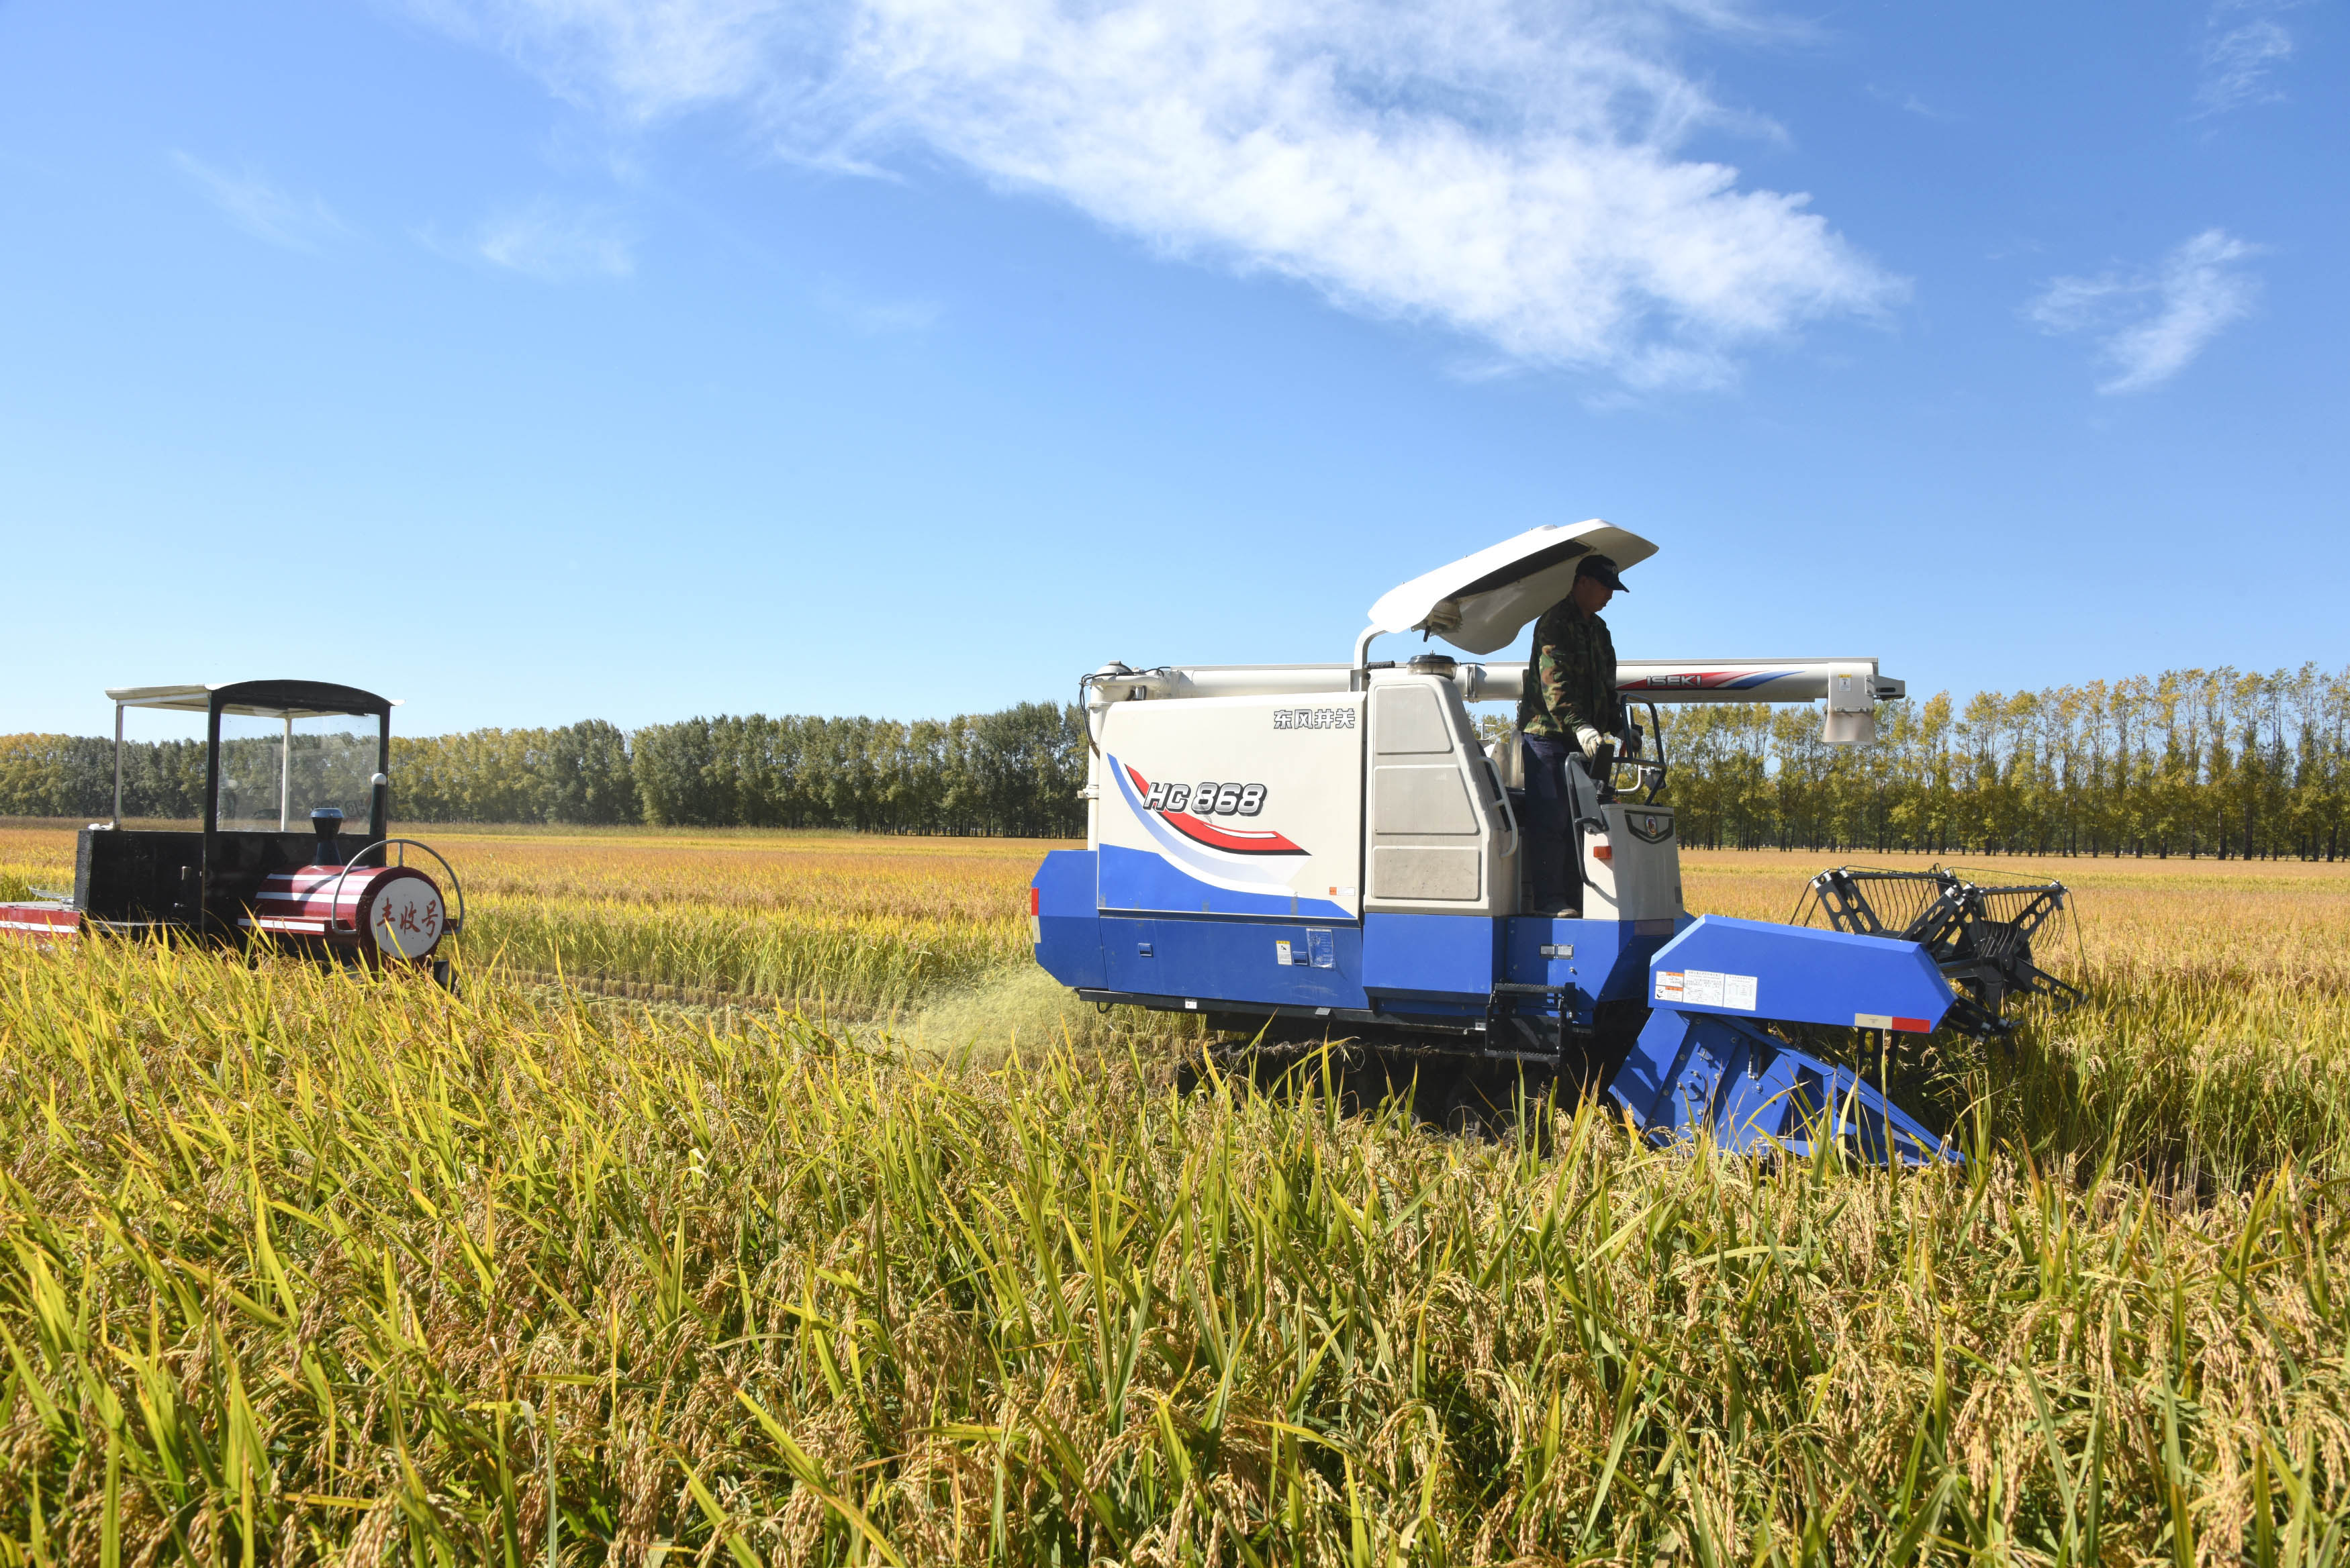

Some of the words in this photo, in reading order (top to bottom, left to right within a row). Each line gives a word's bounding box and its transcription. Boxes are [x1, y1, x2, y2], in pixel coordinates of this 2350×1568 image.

[1646, 675, 1701, 687] ISEKI
[1274, 708, 1355, 729] 东风井关
[1143, 782, 1191, 812] HC
[1191, 782, 1268, 816] 868
[377, 897, 438, 940] 丰收号
